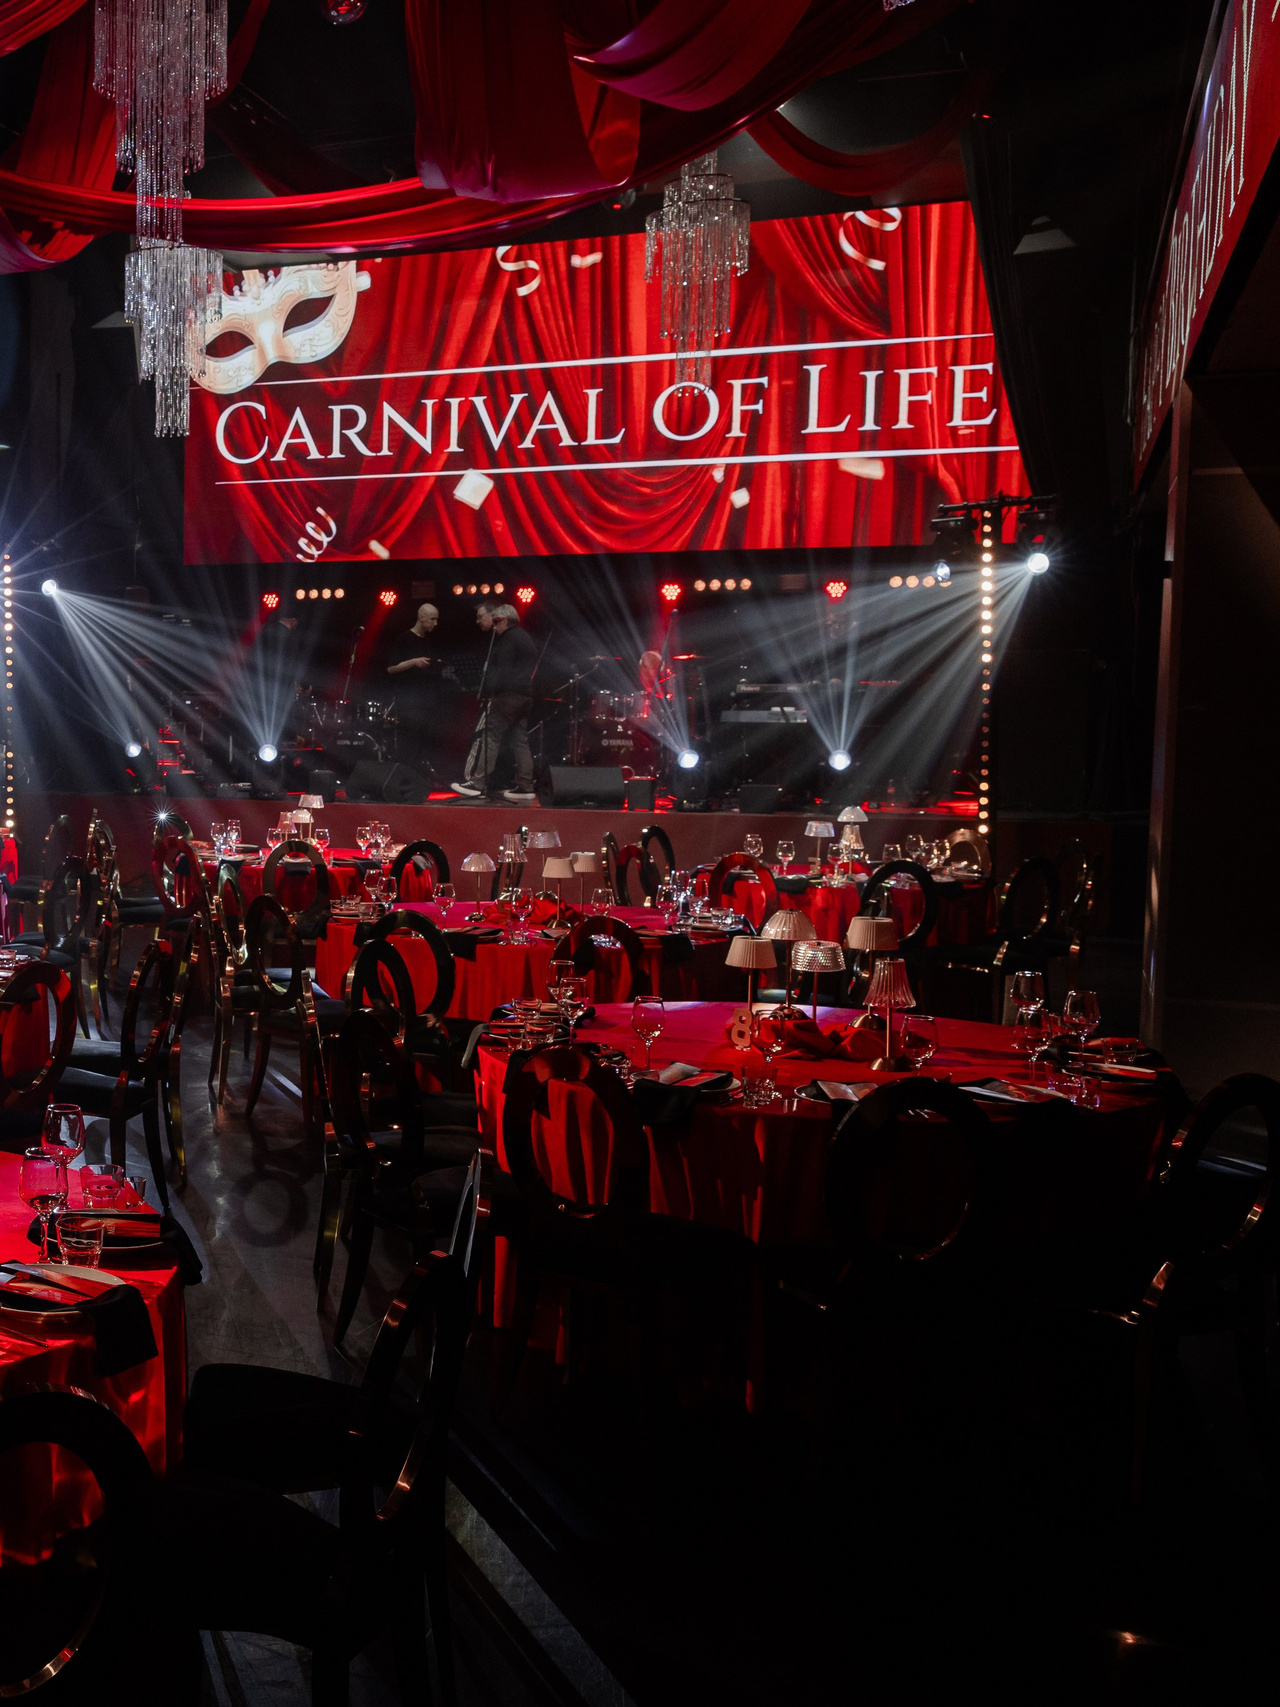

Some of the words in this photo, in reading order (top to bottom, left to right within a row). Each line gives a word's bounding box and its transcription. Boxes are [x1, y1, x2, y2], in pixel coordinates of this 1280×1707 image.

[1165, 0, 1257, 389] BIRTHDAY
[215, 388, 626, 465] CARNIVAL
[652, 376, 769, 441] OF
[801, 362, 997, 434] LIFE
[731, 1008, 752, 1047] 8
